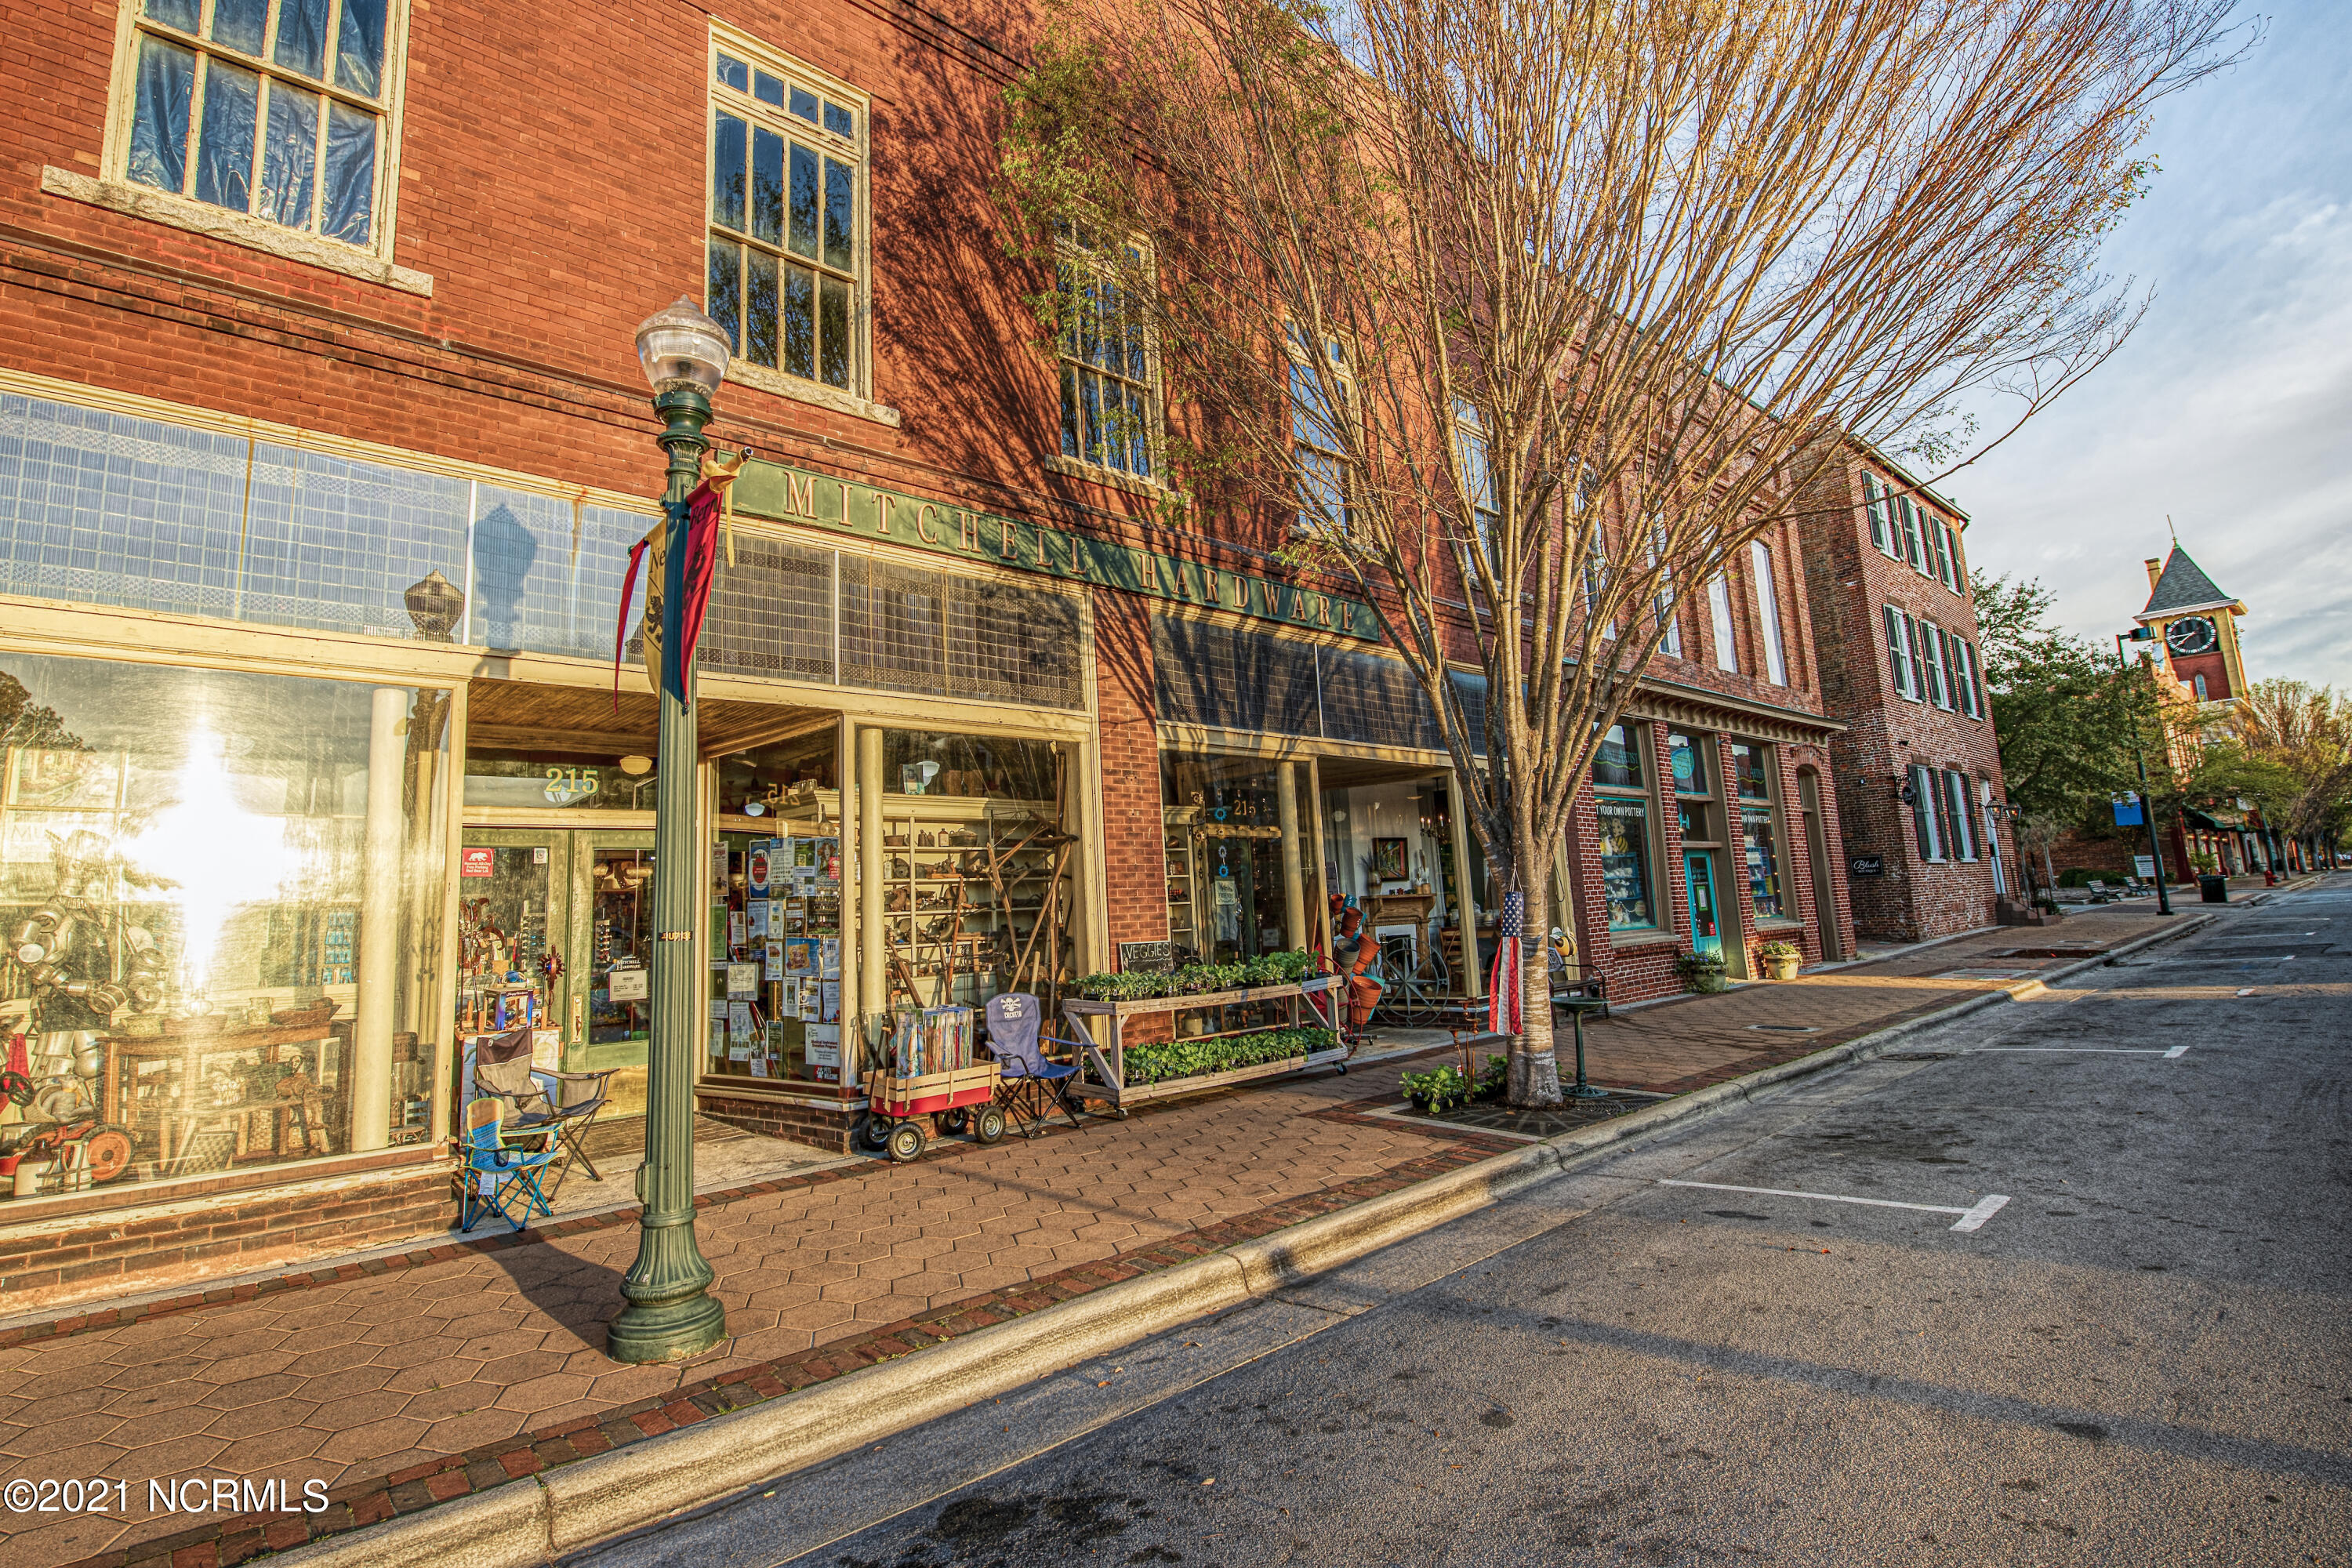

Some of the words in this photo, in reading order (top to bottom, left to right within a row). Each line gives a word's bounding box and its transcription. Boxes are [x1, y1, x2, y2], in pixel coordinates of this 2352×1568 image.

[648, 546, 666, 574] Ne
[784, 470, 1087, 575] MITCHELL
[1139, 553, 1353, 631] HARDWARE
[546, 768, 598, 793] 215
[1600, 805, 1613, 815] YOUR
[1613, 806, 1624, 816] OWN
[1625, 807, 1645, 817] POTTERY
[1853, 860, 1879, 869] Blush
[1125, 943, 1171, 959] VEGGIES
